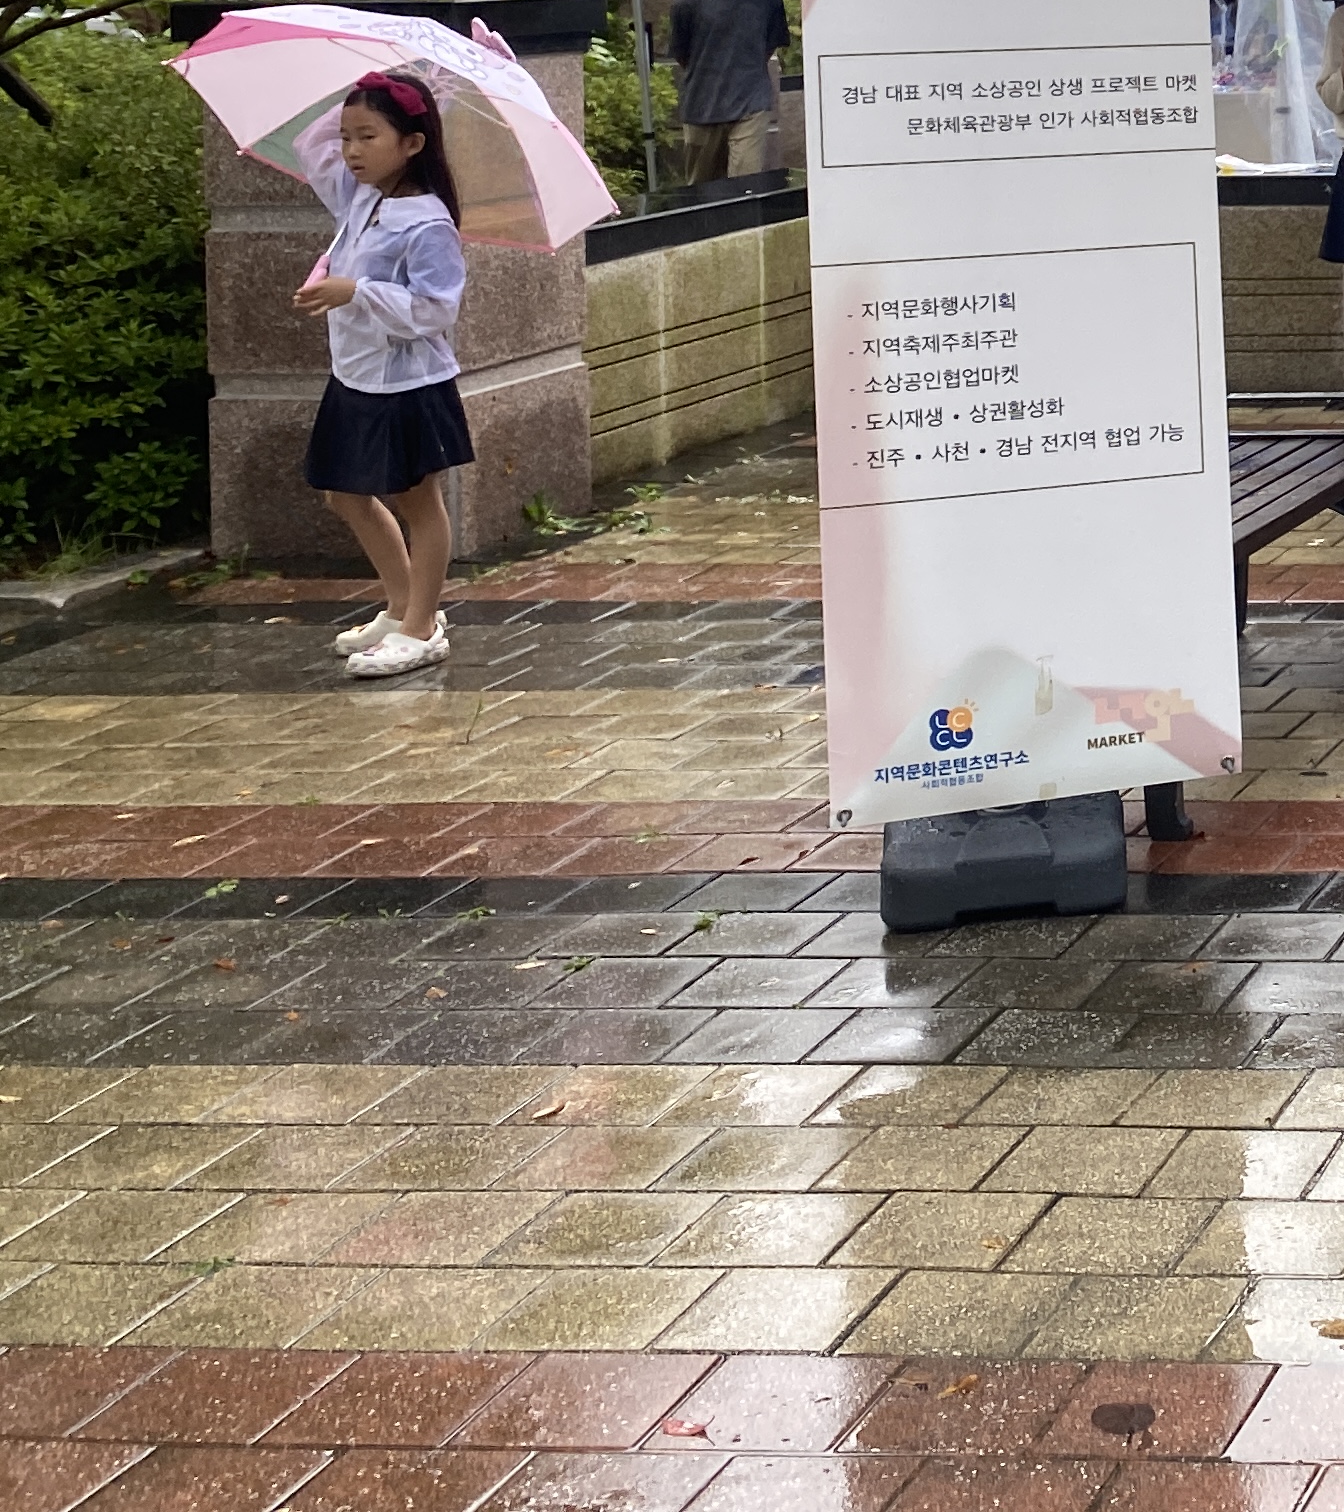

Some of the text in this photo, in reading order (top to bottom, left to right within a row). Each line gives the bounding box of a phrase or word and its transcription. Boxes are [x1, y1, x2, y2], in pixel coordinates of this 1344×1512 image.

[842, 74, 1197, 105] 경남 대표 지역 소상공인 상생 프로젝트 마켓
[907, 105, 1198, 136] 문화체육관광부 인가 사회적협동조합
[861, 291, 1017, 321] 지역문화행사기획
[862, 328, 1018, 357] 지역축제주최주관
[864, 364, 1020, 394] 소상공인협업마켓
[866, 397, 1065, 432] 도시재생 상권활성화
[867, 423, 1185, 470] 진주 사천 경남 전지역 협업 가능
[1087, 731, 1146, 750] MARKET
[874, 750, 1030, 783] 지역문화콘텐츠연구소
